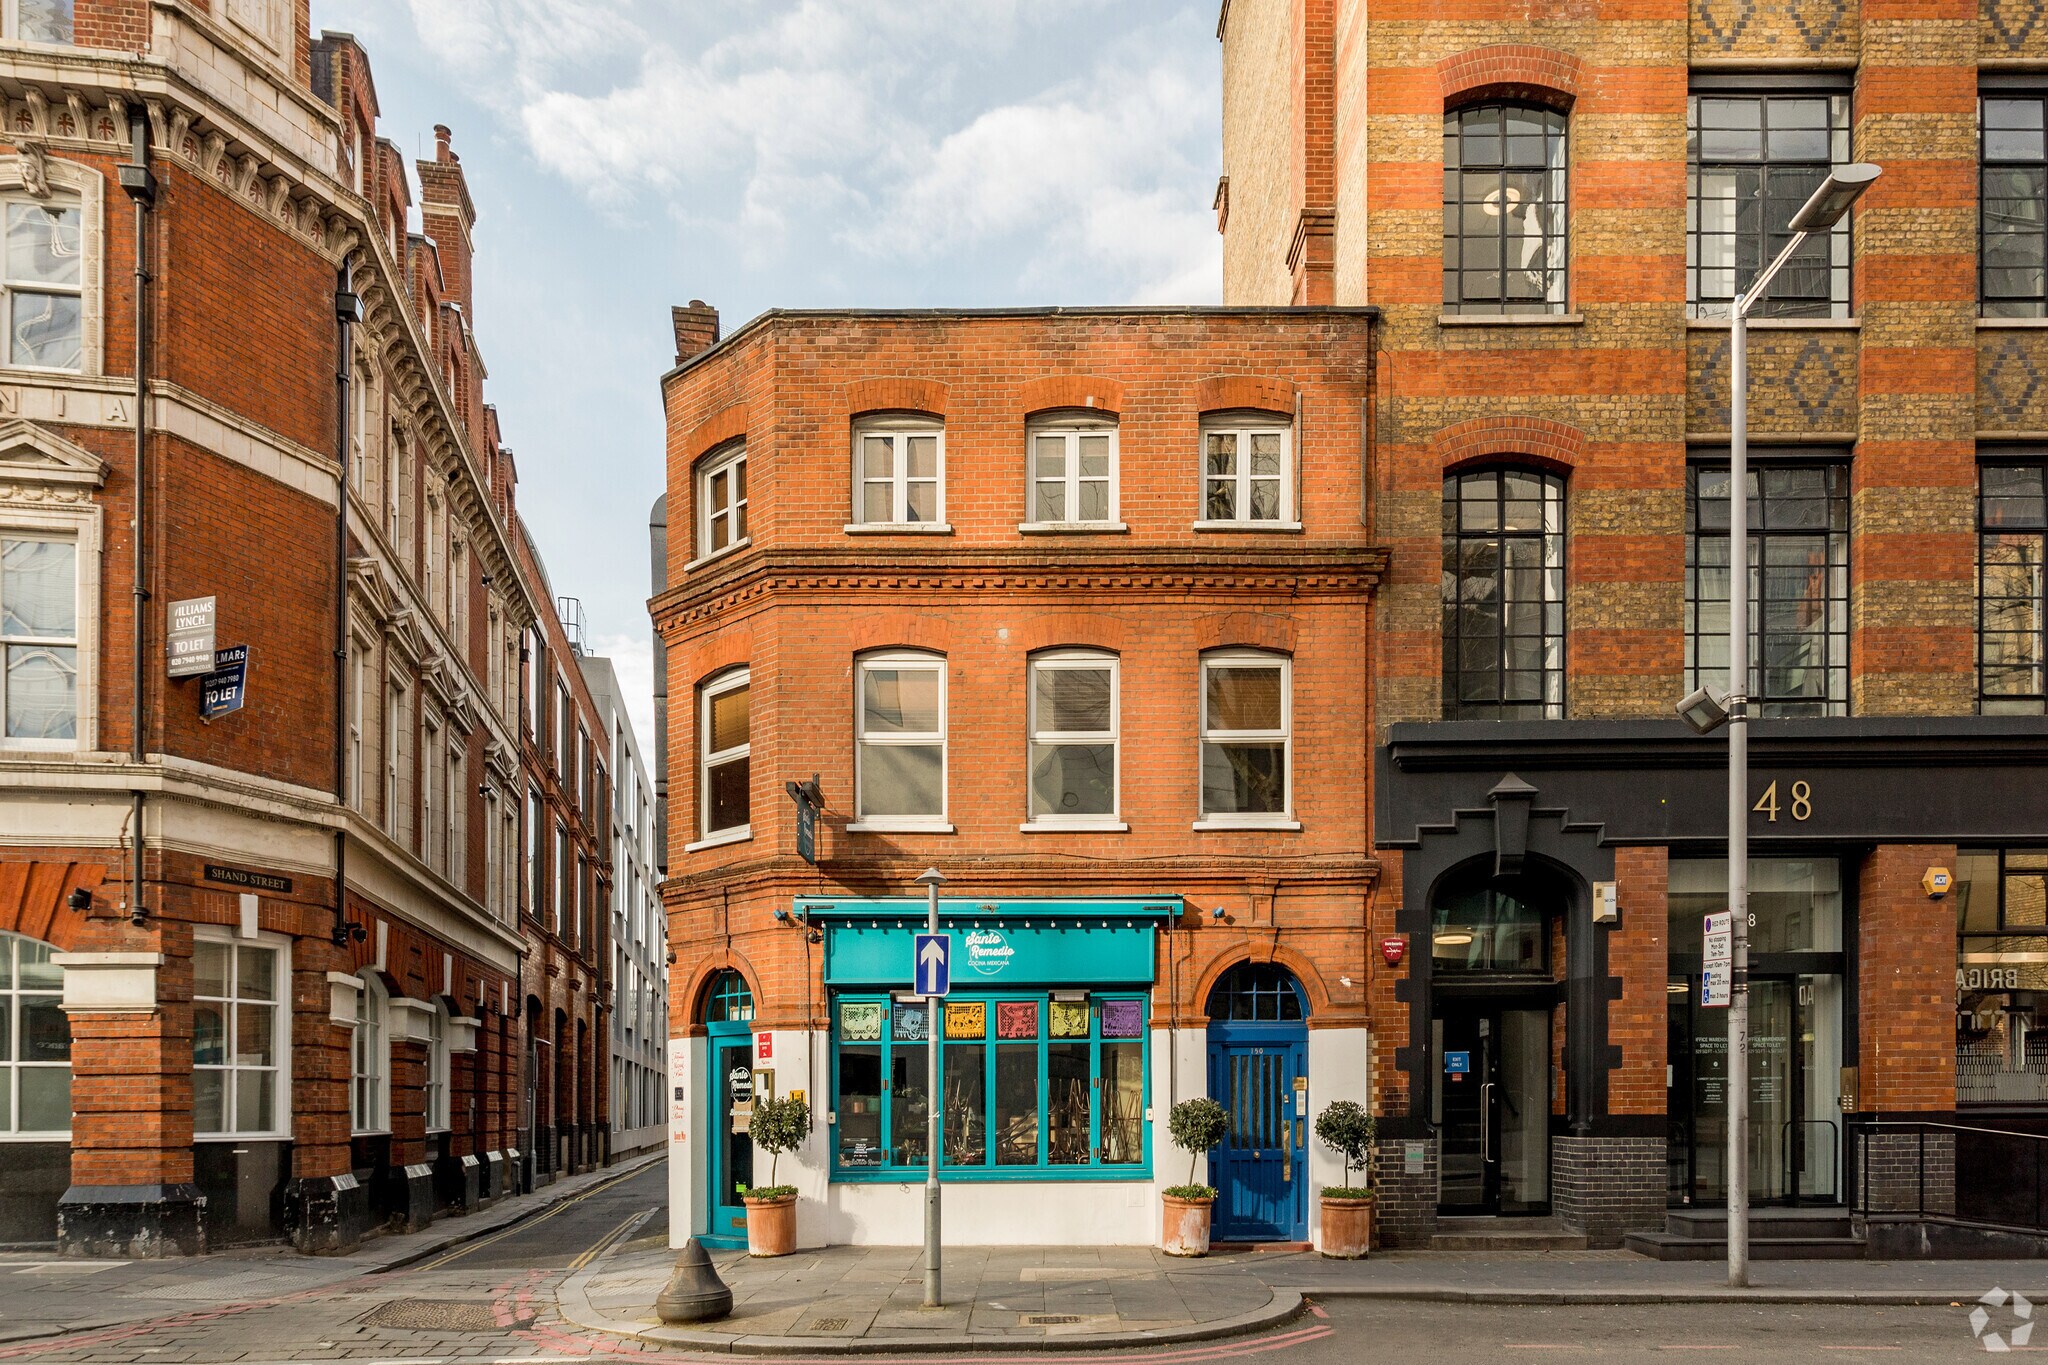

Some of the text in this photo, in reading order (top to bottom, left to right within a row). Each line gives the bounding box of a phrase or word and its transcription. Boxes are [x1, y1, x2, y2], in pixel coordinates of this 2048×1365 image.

[175, 601, 213, 617] ILLIAMS
[176, 614, 206, 629] LYNCH
[174, 639, 204, 653] TO LET
[171, 657, 182, 666] 020
[215, 649, 245, 664] LMARs
[206, 686, 238, 706] TO LET
[1752, 779, 1812, 821] 48
[212, 868, 286, 889] SHAND STREET
[1935, 876, 1946, 885] ADT
[965, 931, 1001, 948] Santo
[971, 945, 1015, 959] Remedio
